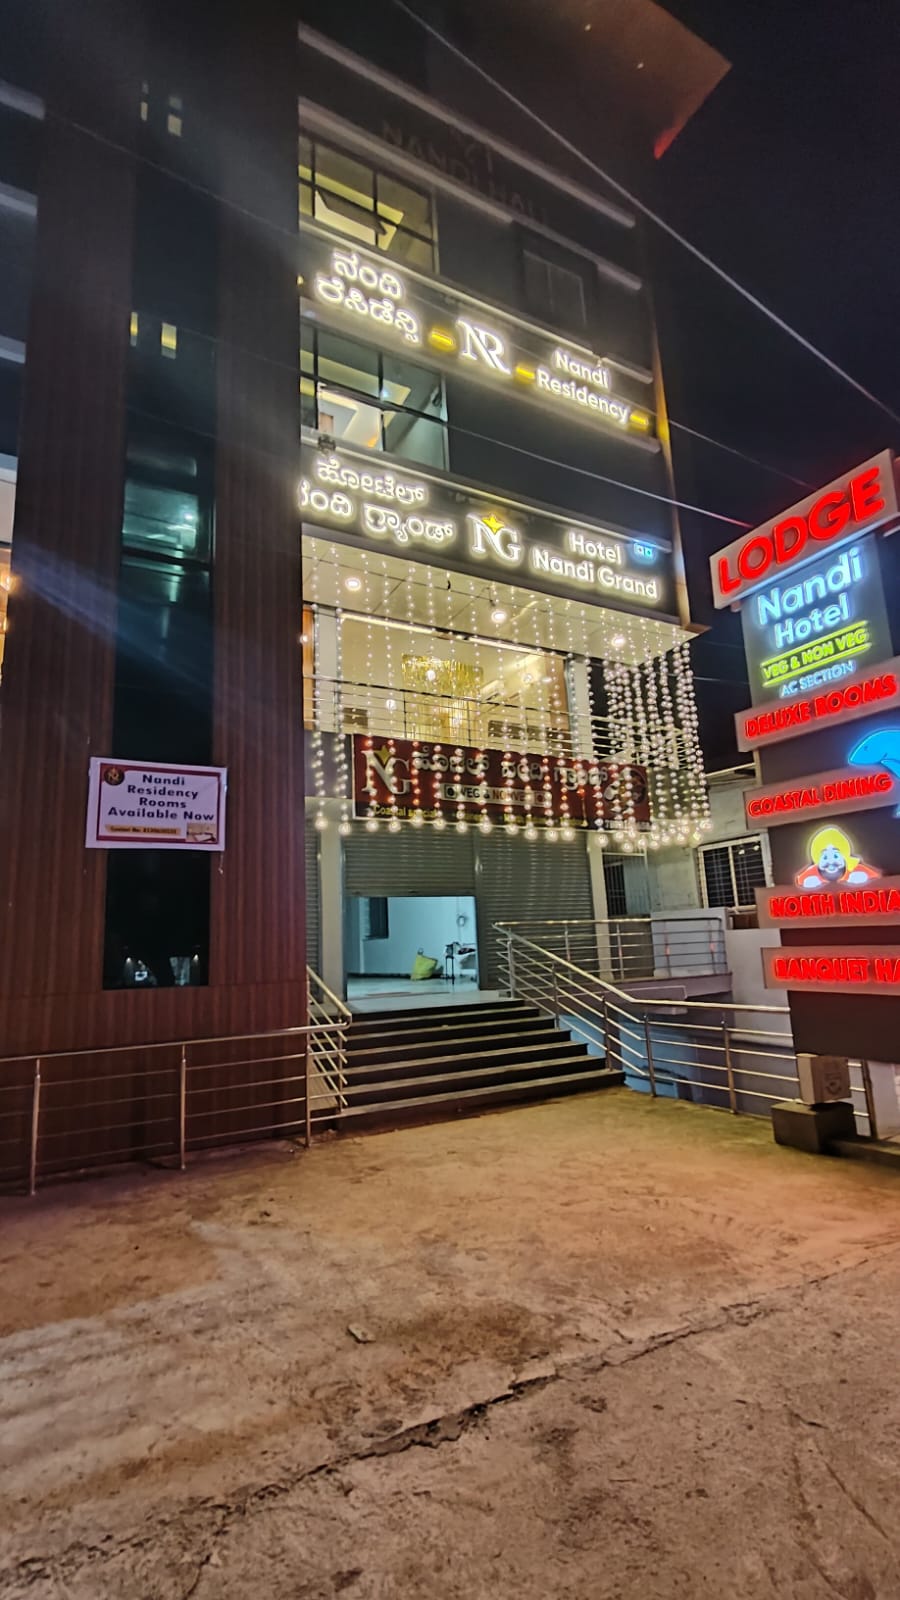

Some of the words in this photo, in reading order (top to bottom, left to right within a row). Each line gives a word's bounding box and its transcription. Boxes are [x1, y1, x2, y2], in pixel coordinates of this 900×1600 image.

[332, 249, 402, 299] ನಂದಿ
[554, 350, 609, 388] Nandi
[536, 368, 629, 423] Residency
[466, 512, 521, 561] NG
[569, 532, 622, 562] Hotel
[718, 466, 885, 595] LODGE
[533, 550, 594, 581] Nandi
[597, 568, 659, 599] Grand
[757, 546, 864, 626] Nandi
[774, 593, 850, 648] Hotel
[763, 659, 789, 679] VEG
[790, 655, 801, 669] &
[802, 643, 834, 665] NON
[836, 628, 868, 649] VEG
[780, 681, 799, 697] AC
[800, 660, 855, 690] SECTION
[746, 702, 811, 738] DELUXE
[815, 675, 897, 717] ROOMS
[127, 785, 199, 800] Residency
[142, 774, 185, 786] Nandi
[749, 787, 820, 817] COASTAL
[824, 773, 893, 801] DINING
[108, 807, 178, 820] Available
[183, 811, 215, 821] Now
[139, 797, 187, 809] Rooms
[770, 894, 835, 918] NORTH
[775, 958, 868, 981] BANQUET
